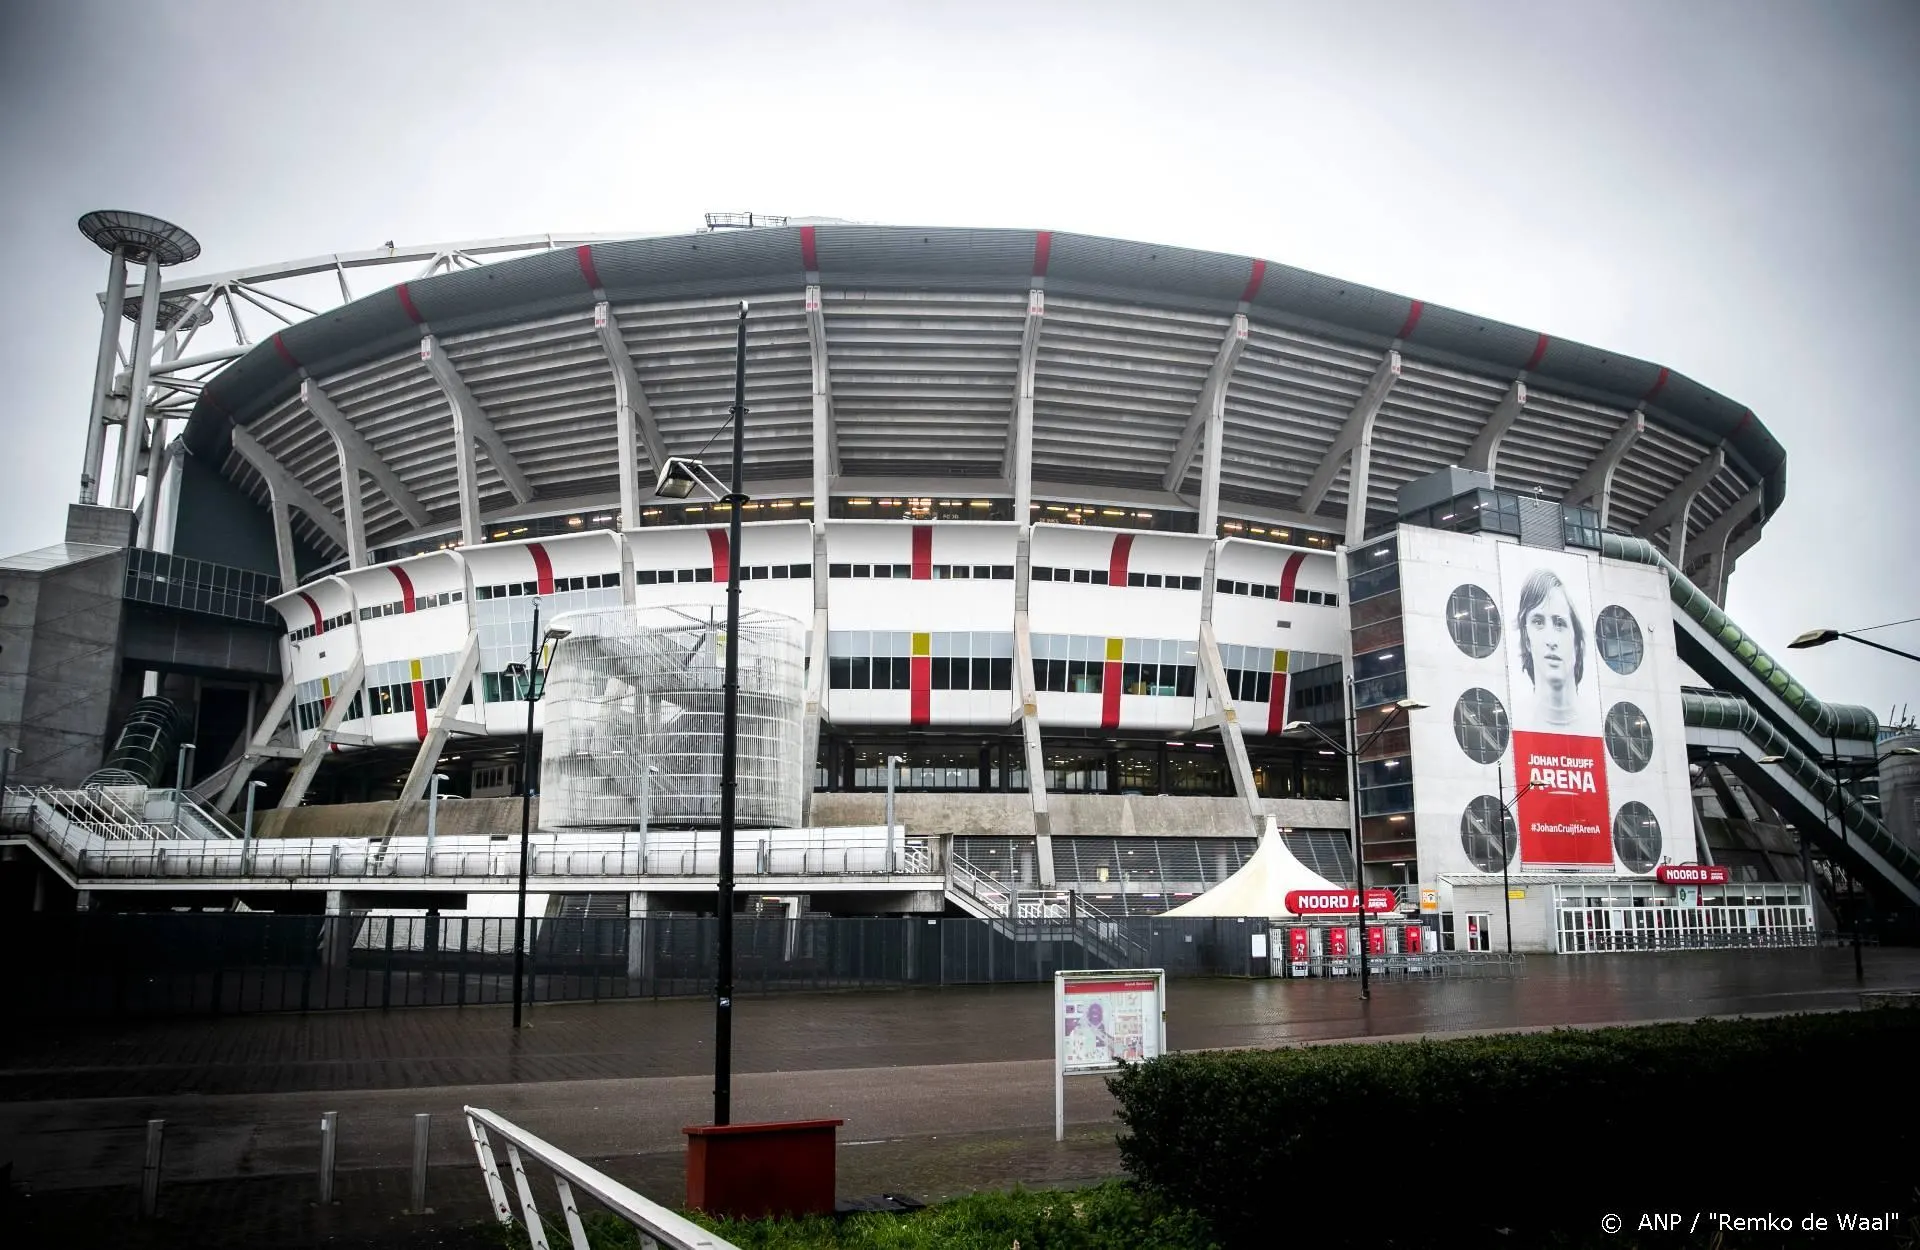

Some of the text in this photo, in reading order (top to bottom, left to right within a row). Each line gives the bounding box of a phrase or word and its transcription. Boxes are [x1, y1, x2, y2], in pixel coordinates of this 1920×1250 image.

[1528, 754, 1558, 767] JOHAN
[1529, 768, 1597, 793] ARENA
[1666, 869, 1707, 880] NOORD B
[1298, 895, 1349, 909] NOORD
